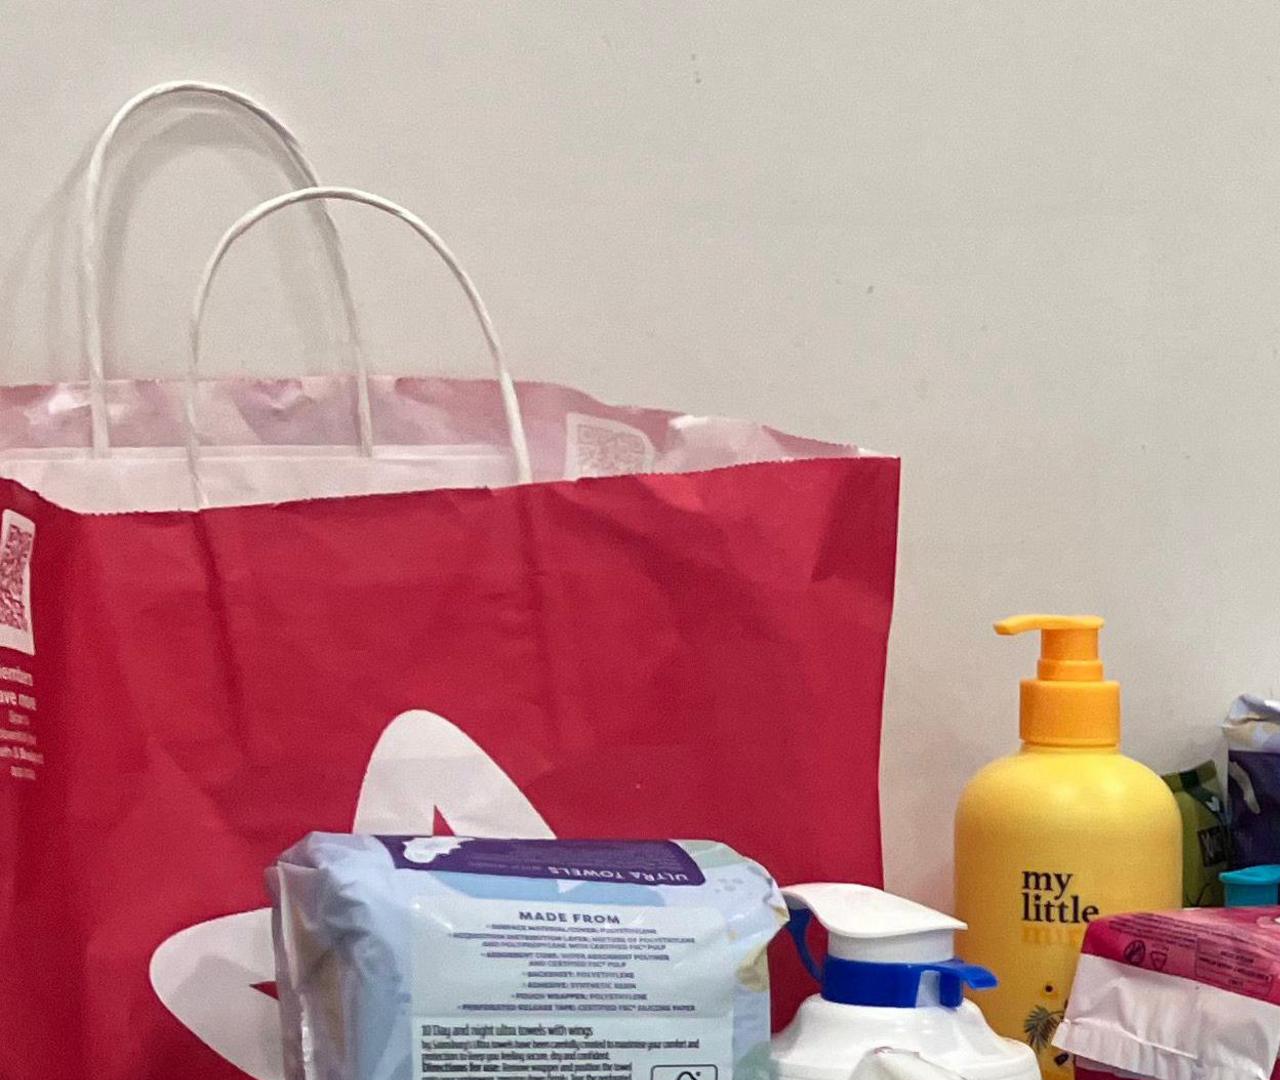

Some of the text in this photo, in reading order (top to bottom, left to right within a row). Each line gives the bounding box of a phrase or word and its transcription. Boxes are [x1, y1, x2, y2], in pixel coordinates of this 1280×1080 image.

[629, 871, 689, 882] ULTRA
[1022, 870, 1074, 901] my
[518, 911, 621, 924] MADE FROM
[1022, 892, 1100, 924] little
